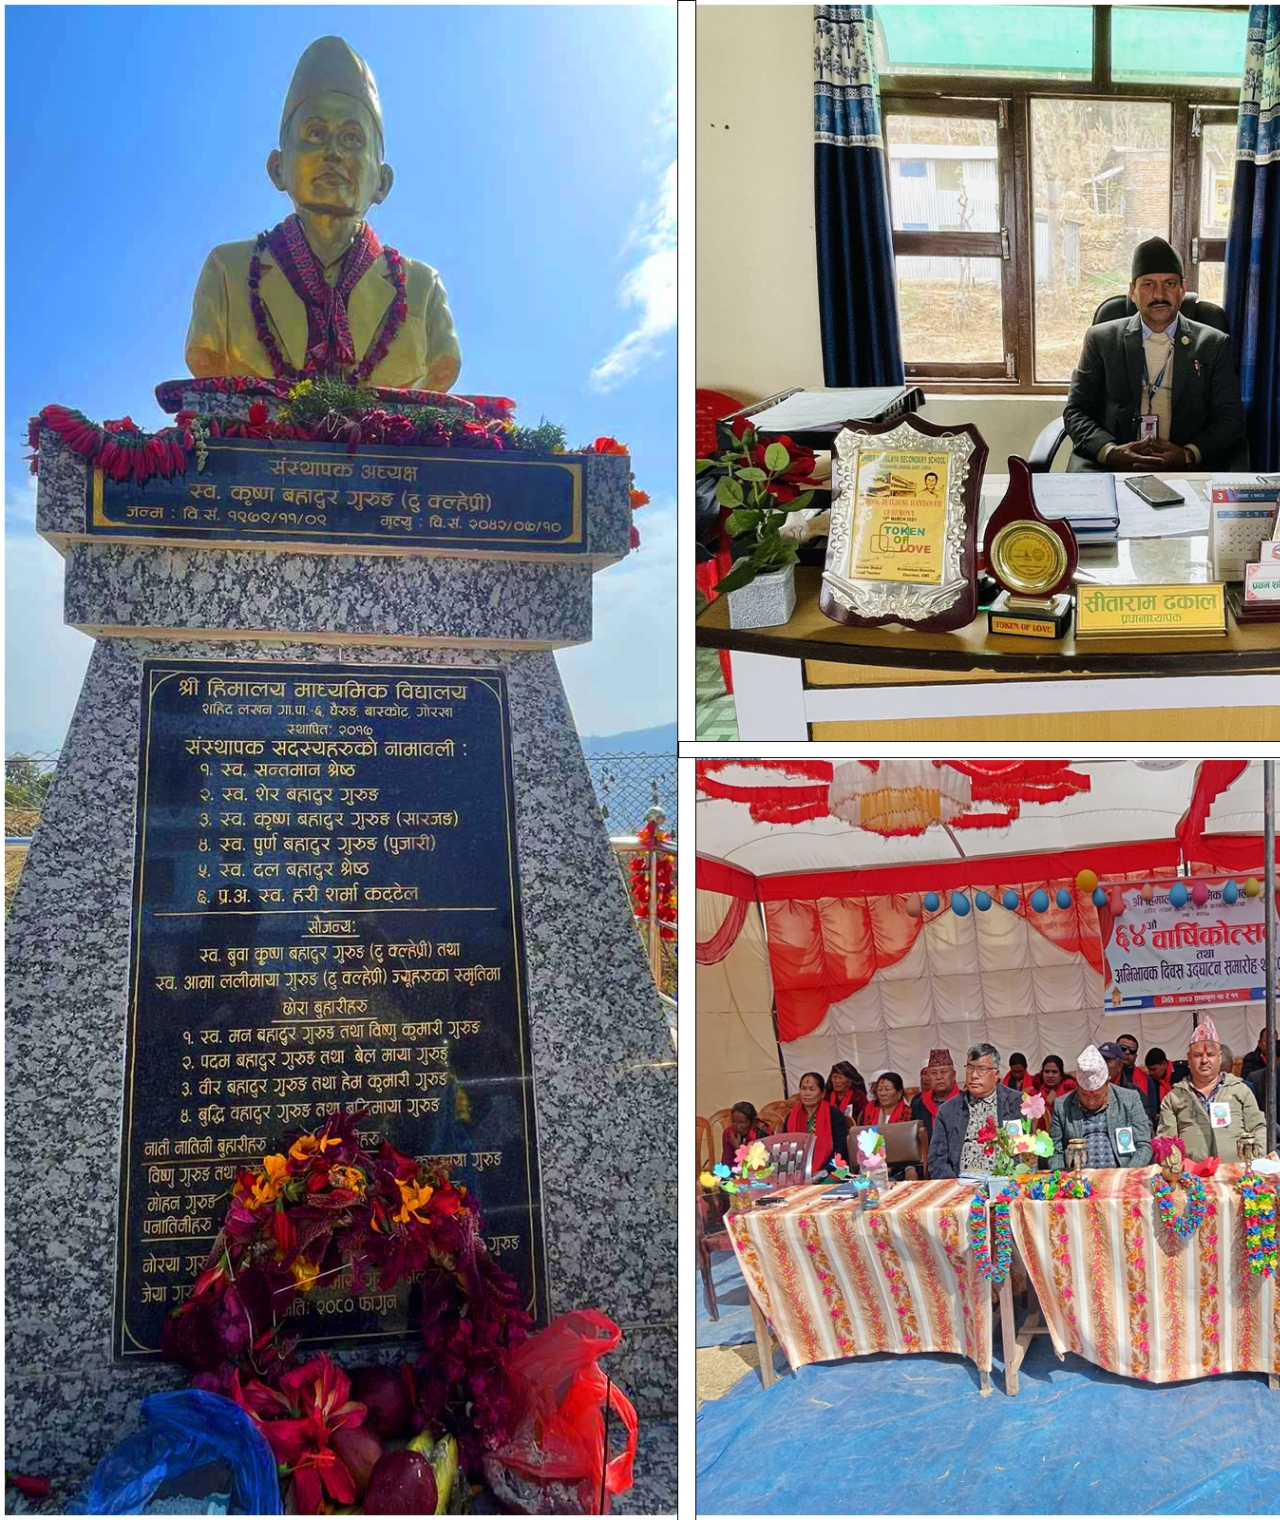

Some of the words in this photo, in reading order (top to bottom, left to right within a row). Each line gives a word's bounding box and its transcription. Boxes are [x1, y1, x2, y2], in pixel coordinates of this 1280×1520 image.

[269, 457, 353, 476] संस्थापक
[361, 465, 418, 482] अध्यक्ष
[190, 484, 220, 499] स्व.
[230, 485, 274, 505] कृष्ण
[282, 488, 339, 509] बहादुर
[126, 506, 164, 518] जन्म
[183, 506, 219, 520] वि.सं.
[228, 510, 326, 525] १९७९/११/०९
[429, 514, 461, 528] वि.सं.
[884, 526, 926, 536] TOKEN
[894, 536, 909, 544] OF
[900, 544, 932, 554] LOVE
[1084, 591, 1157, 613] सीताराम
[1164, 593, 1218, 610] ढकाल
[995, 620, 1019, 630] TOKEN
[1020, 623, 1030, 631] OF
[1121, 614, 1182, 624] प्रधानाध्यापक
[178, 677, 199, 695] श्री
[207, 677, 286, 697] हिमालय
[293, 680, 389, 698] माध्यमिक
[395, 681, 467, 699] विद्यालय
[202, 701, 232, 715] शहिद
[237, 704, 272, 714] लखन
[416, 703, 452, 717] गोरखा
[286, 722, 332, 734] स्थापित:
[339, 725, 373, 736] २०१७
[184, 736, 265, 755] संस्थापक
[271, 736, 378, 757] सदस्यहरुको
[384, 738, 455, 756] नामावली
[220, 763, 246, 776] स्व.
[254, 763, 321, 776] सन्तमान
[327, 759, 356, 776] श्रेष्ठ
[222, 787, 247, 801] स्व.
[255, 783, 280, 801] शेर
[286, 788, 333, 805] बहादुर
[219, 812, 245, 826] स्व.
[253, 812, 291, 830] कृष्ण
[297, 812, 344, 830] बहादुर
[218, 837, 245, 851] स्व.
[283, 837, 331, 855] बहादुर
[218, 863, 245, 876] स्व.
[253, 862, 280, 877] दल
[285, 862, 334, 881] बहादुर
[340, 857, 369, 875] श्रेष्ठ
[218, 889, 250, 904] प्र.अ.
[258, 888, 284, 902] स्व.
[292, 884, 319, 903] हरी
[325, 881, 359, 901] शर्मा
[1115, 923, 1146, 952] ६४
[199, 948, 220, 962] स्व.
[227, 947, 249, 966] बुवा
[254, 946, 283, 965] कृष्ण
[288, 946, 328, 964] बहादुर
[436, 942, 460, 956] तथा
[1196, 949, 1215, 960] तथा
[155, 976, 177, 990] स्व.
[183, 975, 215, 990] आमा
[220, 970, 280, 988] ललीमाया
[453, 964, 500, 986] स्मृतिमा
[1114, 963, 1158, 984] अभिभावक
[1160, 960, 1184, 980] दिवस
[313, 996, 368, 1017] बुहारीहरु
[199, 1030, 222, 1044] स्व.
[228, 1028, 252, 1042] मन
[256, 1027, 296, 1046] बहादुर
[340, 1024, 364, 1040] तथा
[369, 1021, 397, 1041] विष्णु
[401, 1018, 442, 1040] कुमारी
[201, 1053, 231, 1069] पदम
[236, 1052, 276, 1071] बहादुर
[320, 1049, 344, 1064] तथा
[381, 1047, 411, 1062] माया
[198, 1077, 221, 1094] वीर
[226, 1078, 268, 1098] बहादुर
[312, 1075, 336, 1090] तथा
[341, 1070, 362, 1091] हेम
[367, 1070, 409, 1093] कुमारी
